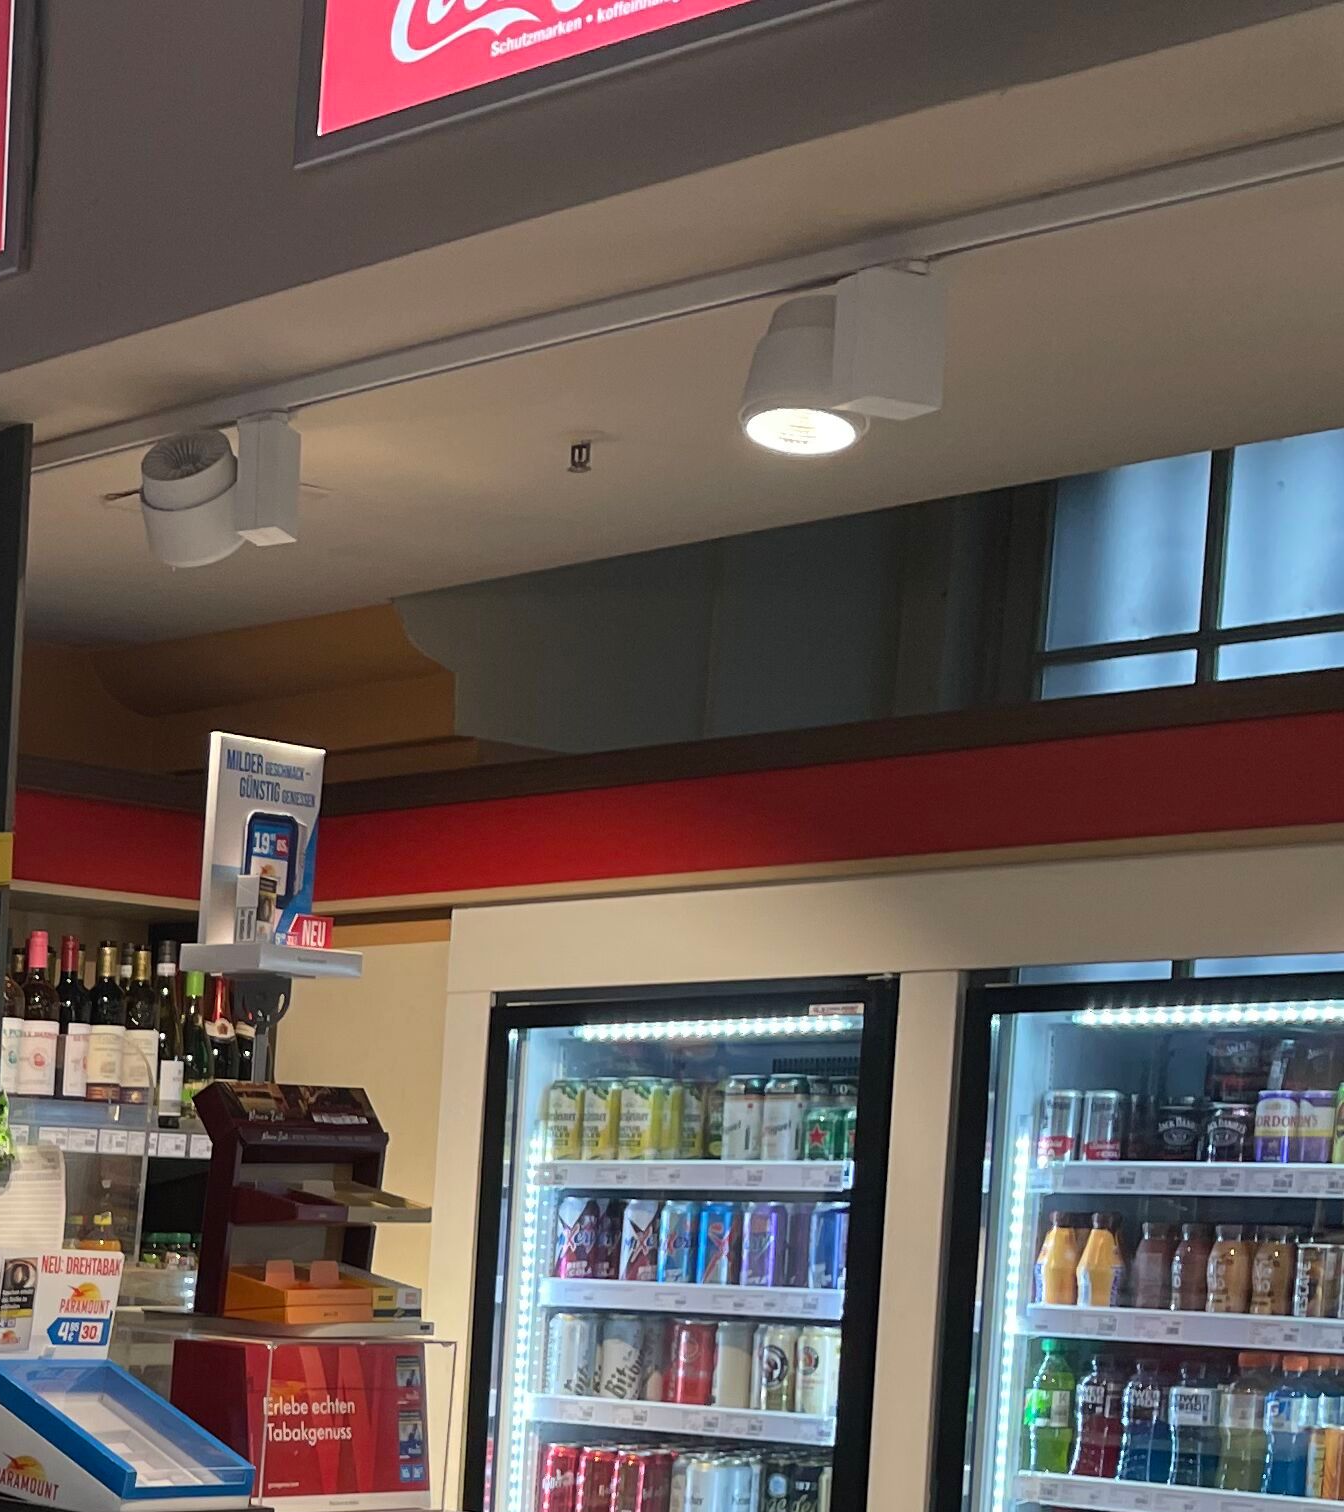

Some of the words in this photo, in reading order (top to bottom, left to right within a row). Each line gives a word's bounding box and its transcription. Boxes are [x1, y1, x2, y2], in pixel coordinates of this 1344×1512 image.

[490, 16, 582, 57] Schutzmarken
[227, 749, 264, 772] MILDER
[240, 776, 280, 801] GÜNSTIG
[302, 919, 326, 948] NEU
[66, 1257, 120, 1276] DREHTABAK
[60, 1299, 110, 1315] PARAMOUNT
[82, 1327, 97, 1340] 30
[264, 1396, 308, 1417] Erlebe
[312, 1398, 355, 1416] echten
[267, 1421, 352, 1444] Tabakgenuss
